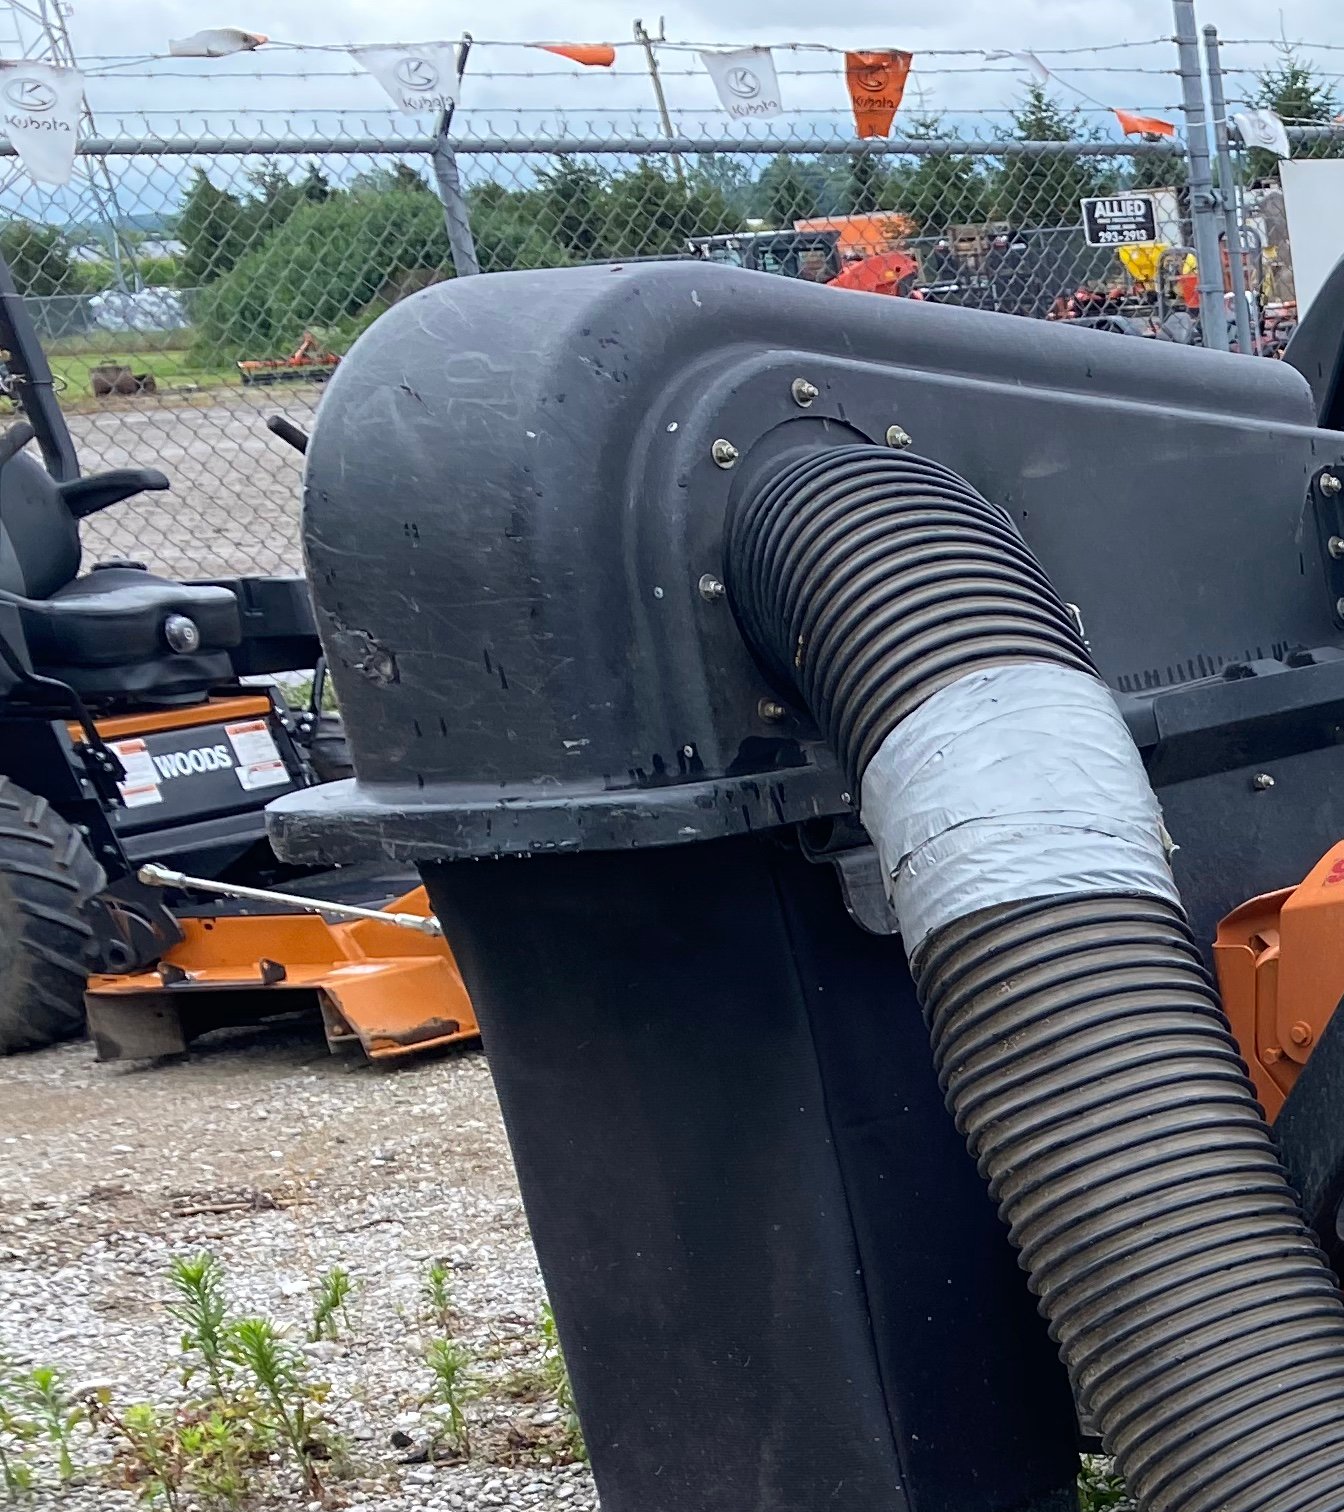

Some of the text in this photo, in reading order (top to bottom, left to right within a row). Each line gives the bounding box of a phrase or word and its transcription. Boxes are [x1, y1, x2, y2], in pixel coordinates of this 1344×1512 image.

[4, 114, 71, 132] Kubota
[1093, 199, 1147, 219] ALLIED
[1098, 228, 1148, 243] 293-2913
[152, 744, 234, 780] WOODS
